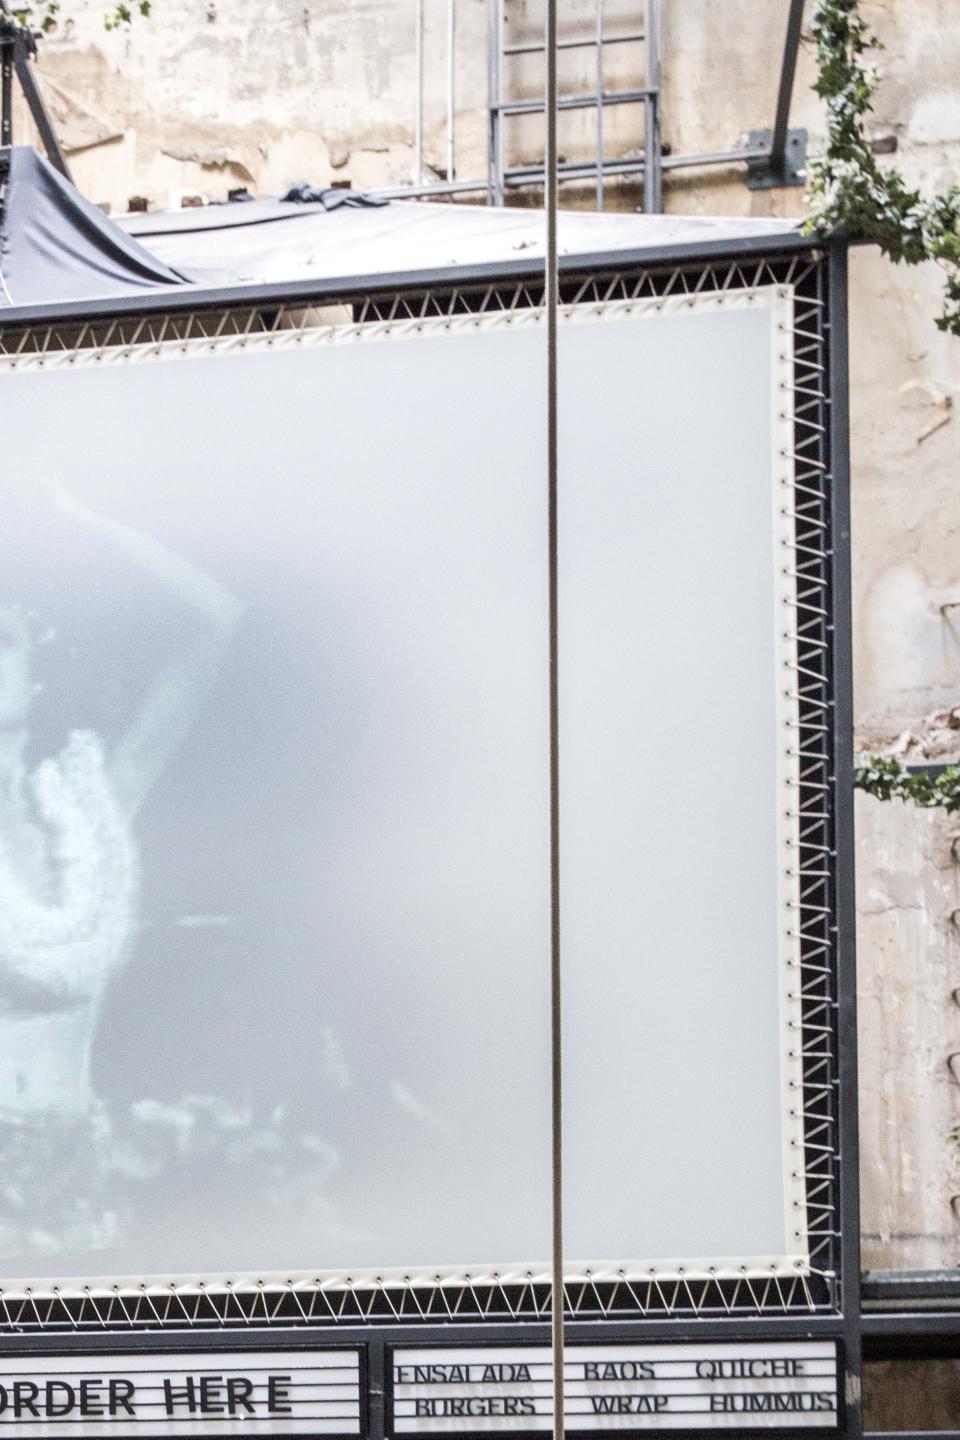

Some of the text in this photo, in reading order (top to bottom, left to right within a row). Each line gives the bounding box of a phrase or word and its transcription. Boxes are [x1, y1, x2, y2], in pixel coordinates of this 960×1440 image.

[396, 1357, 808, 1384] ENSALADA BAOS QUICHE
[163, 1376, 293, 1416] HERE
[415, 1391, 835, 1418] BURGERS WRAP HUMMUS
